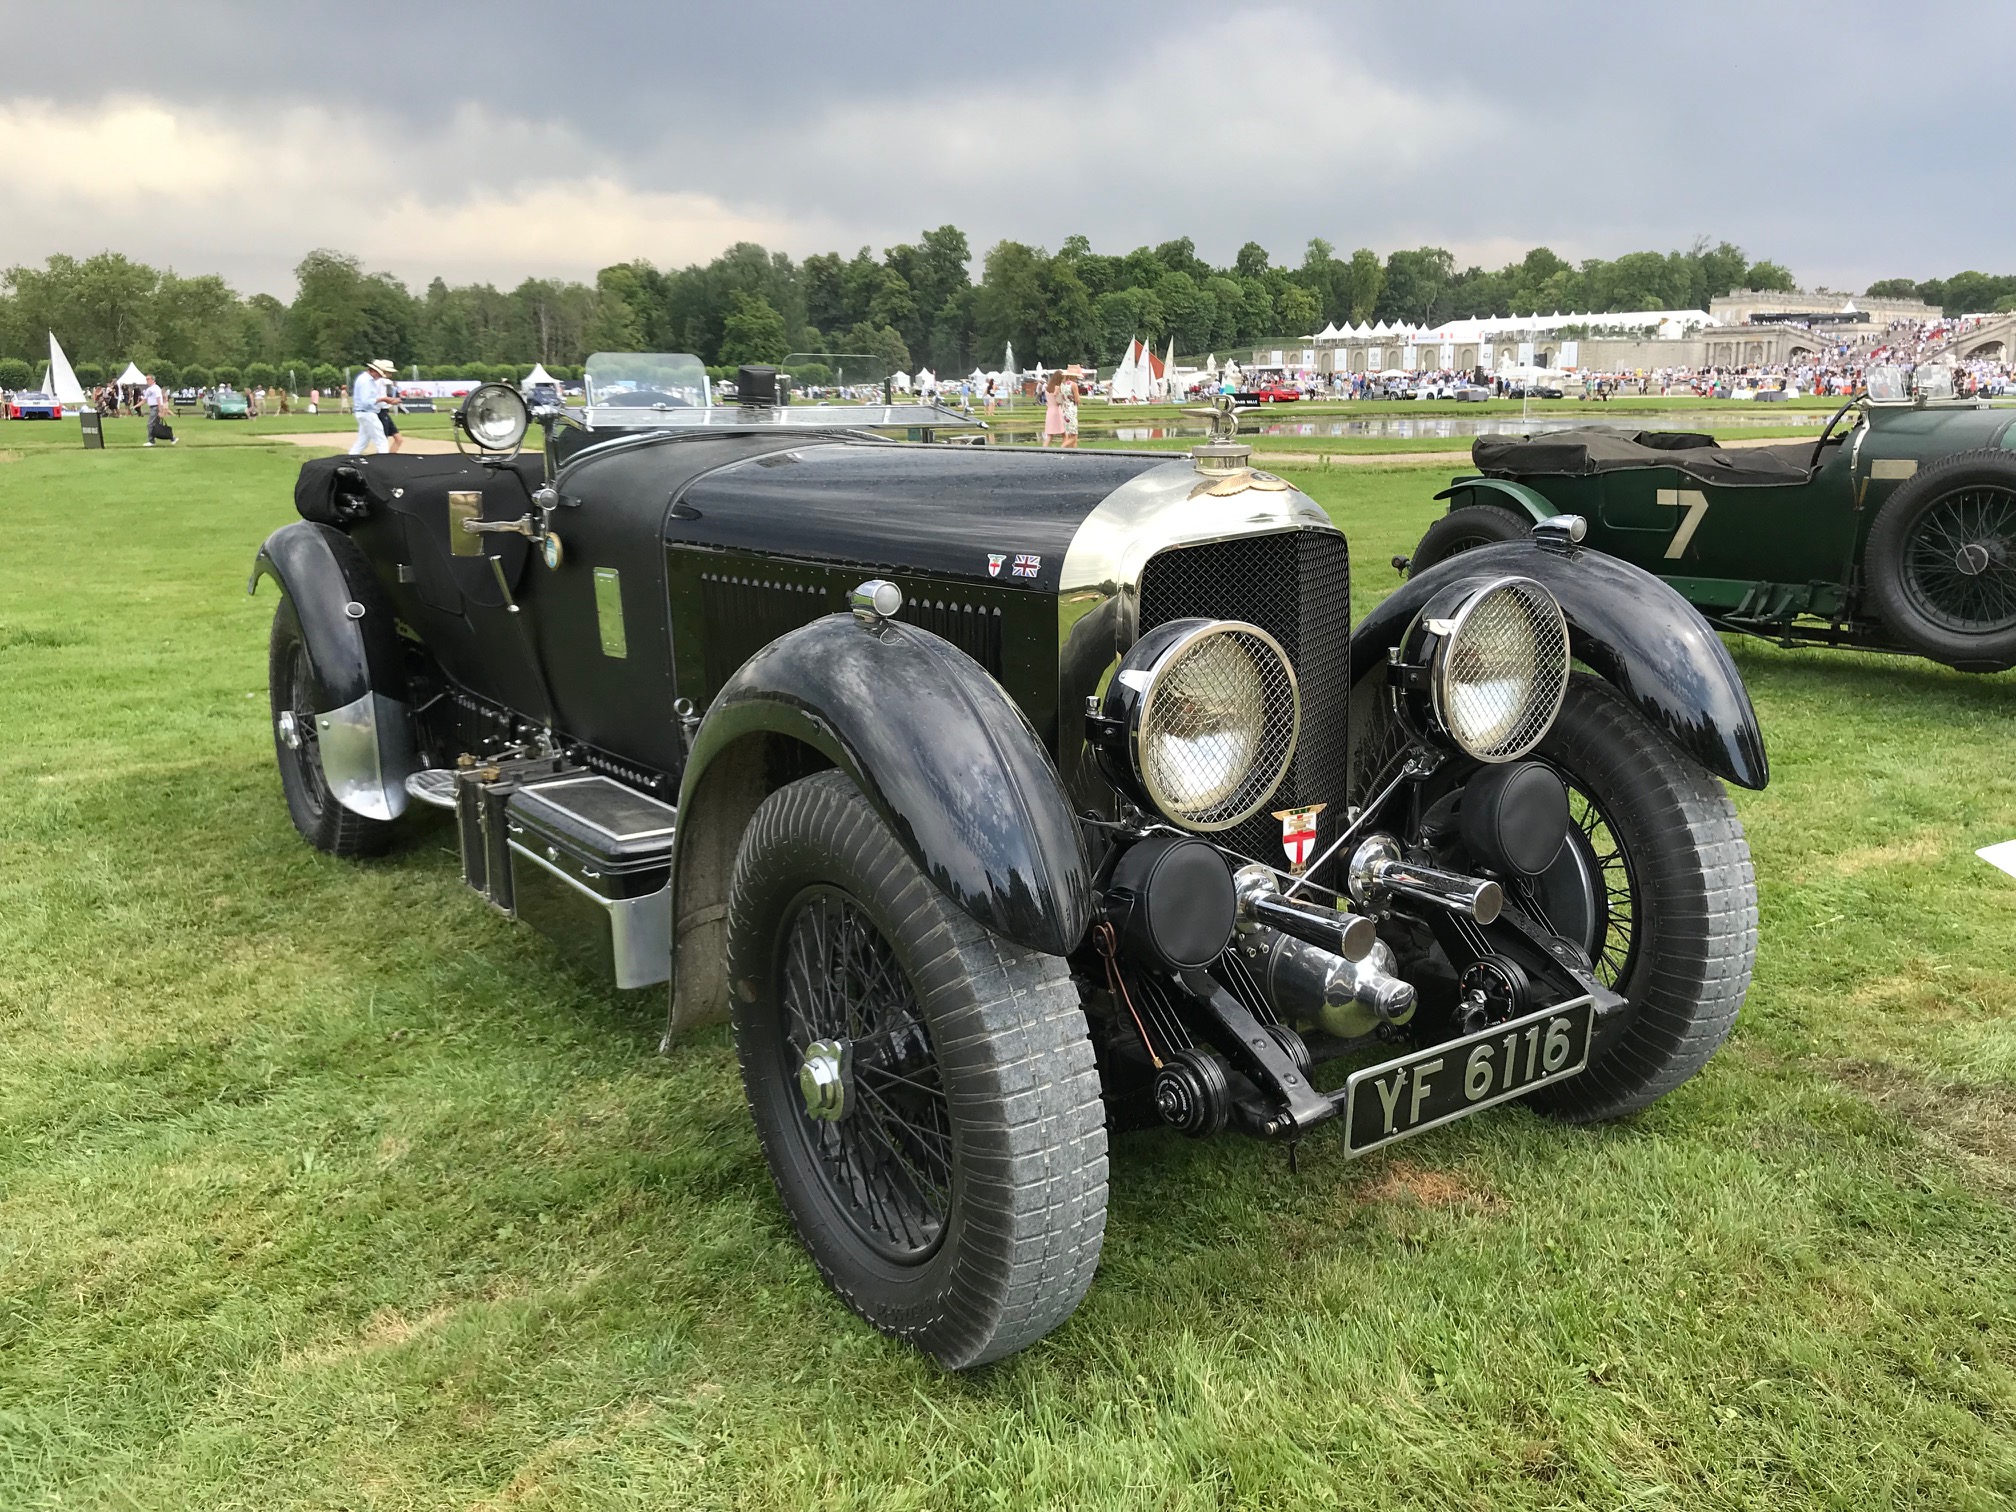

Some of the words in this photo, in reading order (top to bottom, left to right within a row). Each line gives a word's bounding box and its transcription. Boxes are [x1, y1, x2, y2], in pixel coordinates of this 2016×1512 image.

[1657, 489, 1709, 559] 7
[1374, 1058, 1444, 1134] YF
[1464, 1018, 1572, 1100] 6116
